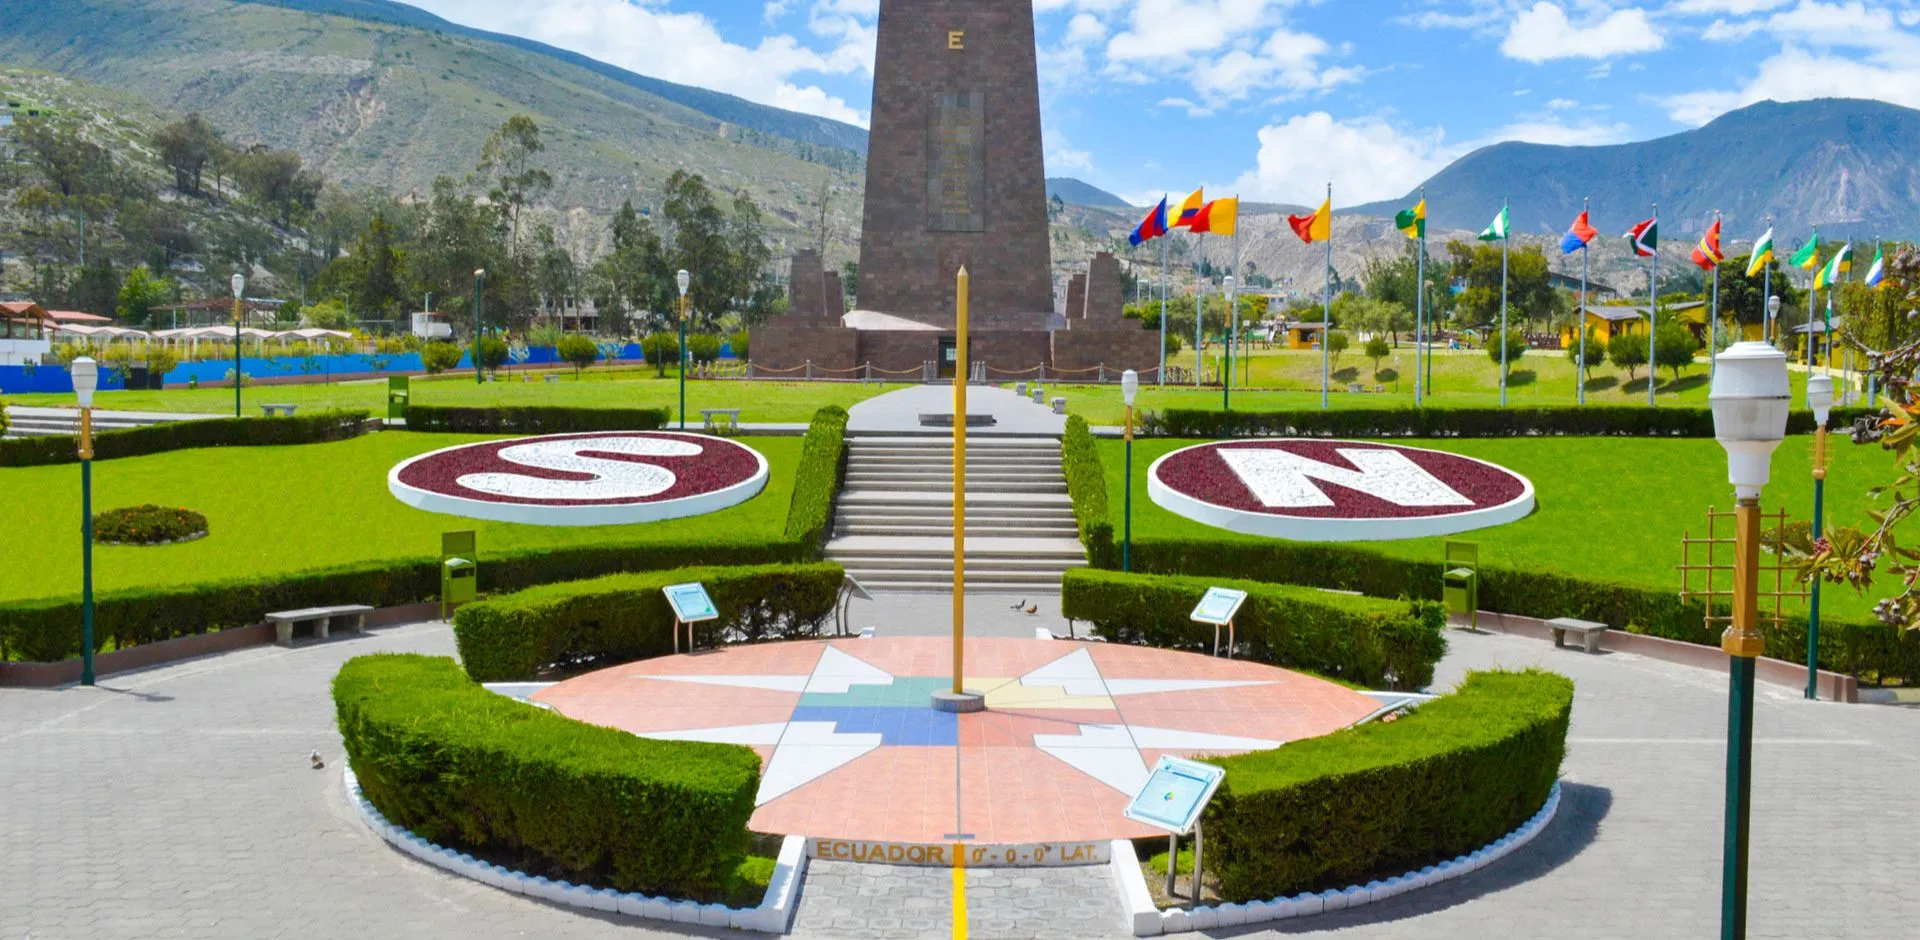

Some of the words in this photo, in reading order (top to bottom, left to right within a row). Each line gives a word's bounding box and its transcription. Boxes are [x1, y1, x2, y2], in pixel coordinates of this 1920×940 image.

[948, 31, 964, 49] E
[455, 436, 704, 500] S
[1216, 448, 1476, 507] N
[816, 840, 945, 864] ECUADOR
[1060, 843, 1099, 861] LAT.
